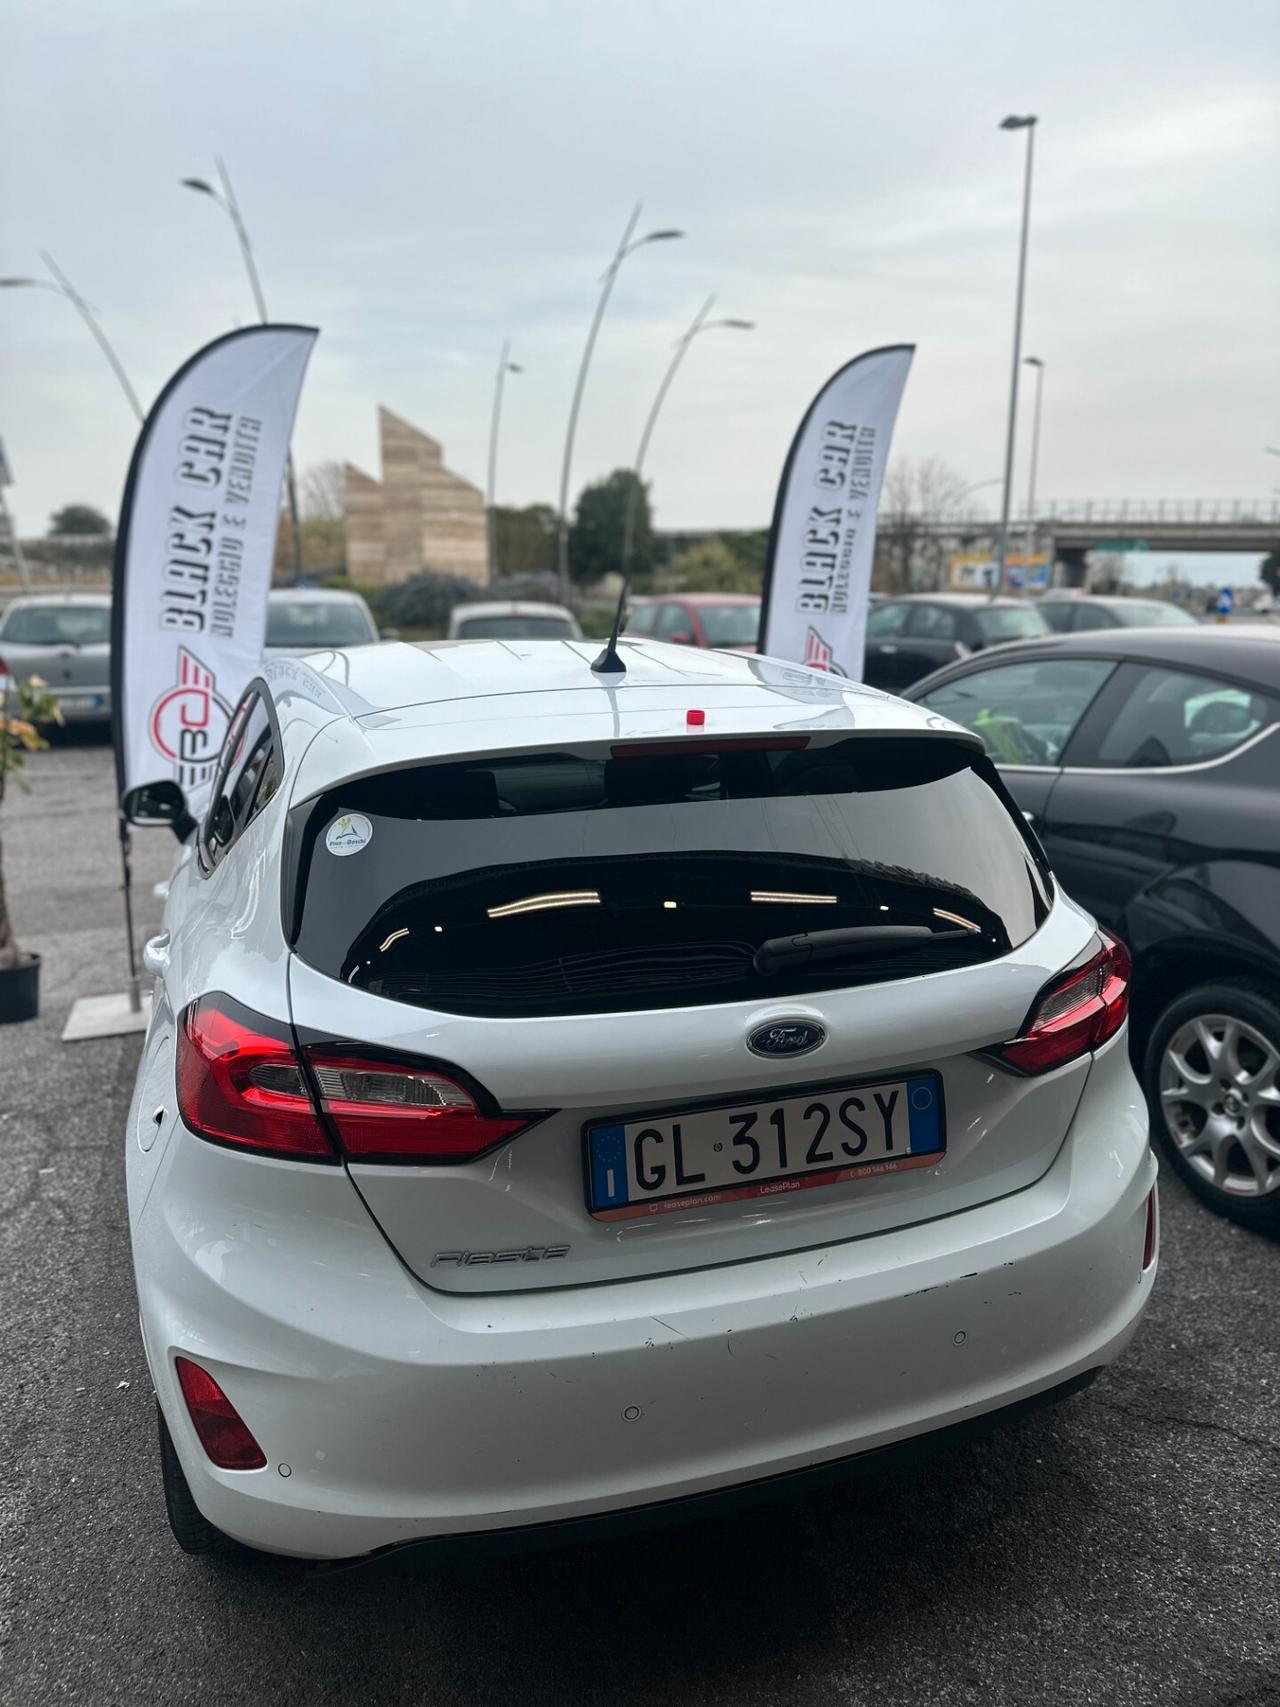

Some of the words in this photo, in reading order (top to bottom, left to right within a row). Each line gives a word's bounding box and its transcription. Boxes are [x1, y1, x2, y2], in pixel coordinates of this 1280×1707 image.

[176, 404, 232, 489] CAR
[224, 415, 262, 504] VENDITA
[816, 419, 857, 491] CAR
[222, 513, 247, 529] E
[162, 504, 216, 633] BLACK
[209, 536, 244, 639] NOLEGGIO
[796, 505, 842, 613] BLACK
[767, 1027, 809, 1049] Ford
[633, 1124, 706, 1191] GL
[729, 1090, 899, 1175] 312SY
[606, 1169, 615, 1198] I
[664, 1194, 721, 1209] leaseplan.com
[759, 1180, 801, 1194] LeasePlan
[430, 1244, 572, 1268] Fiesta
